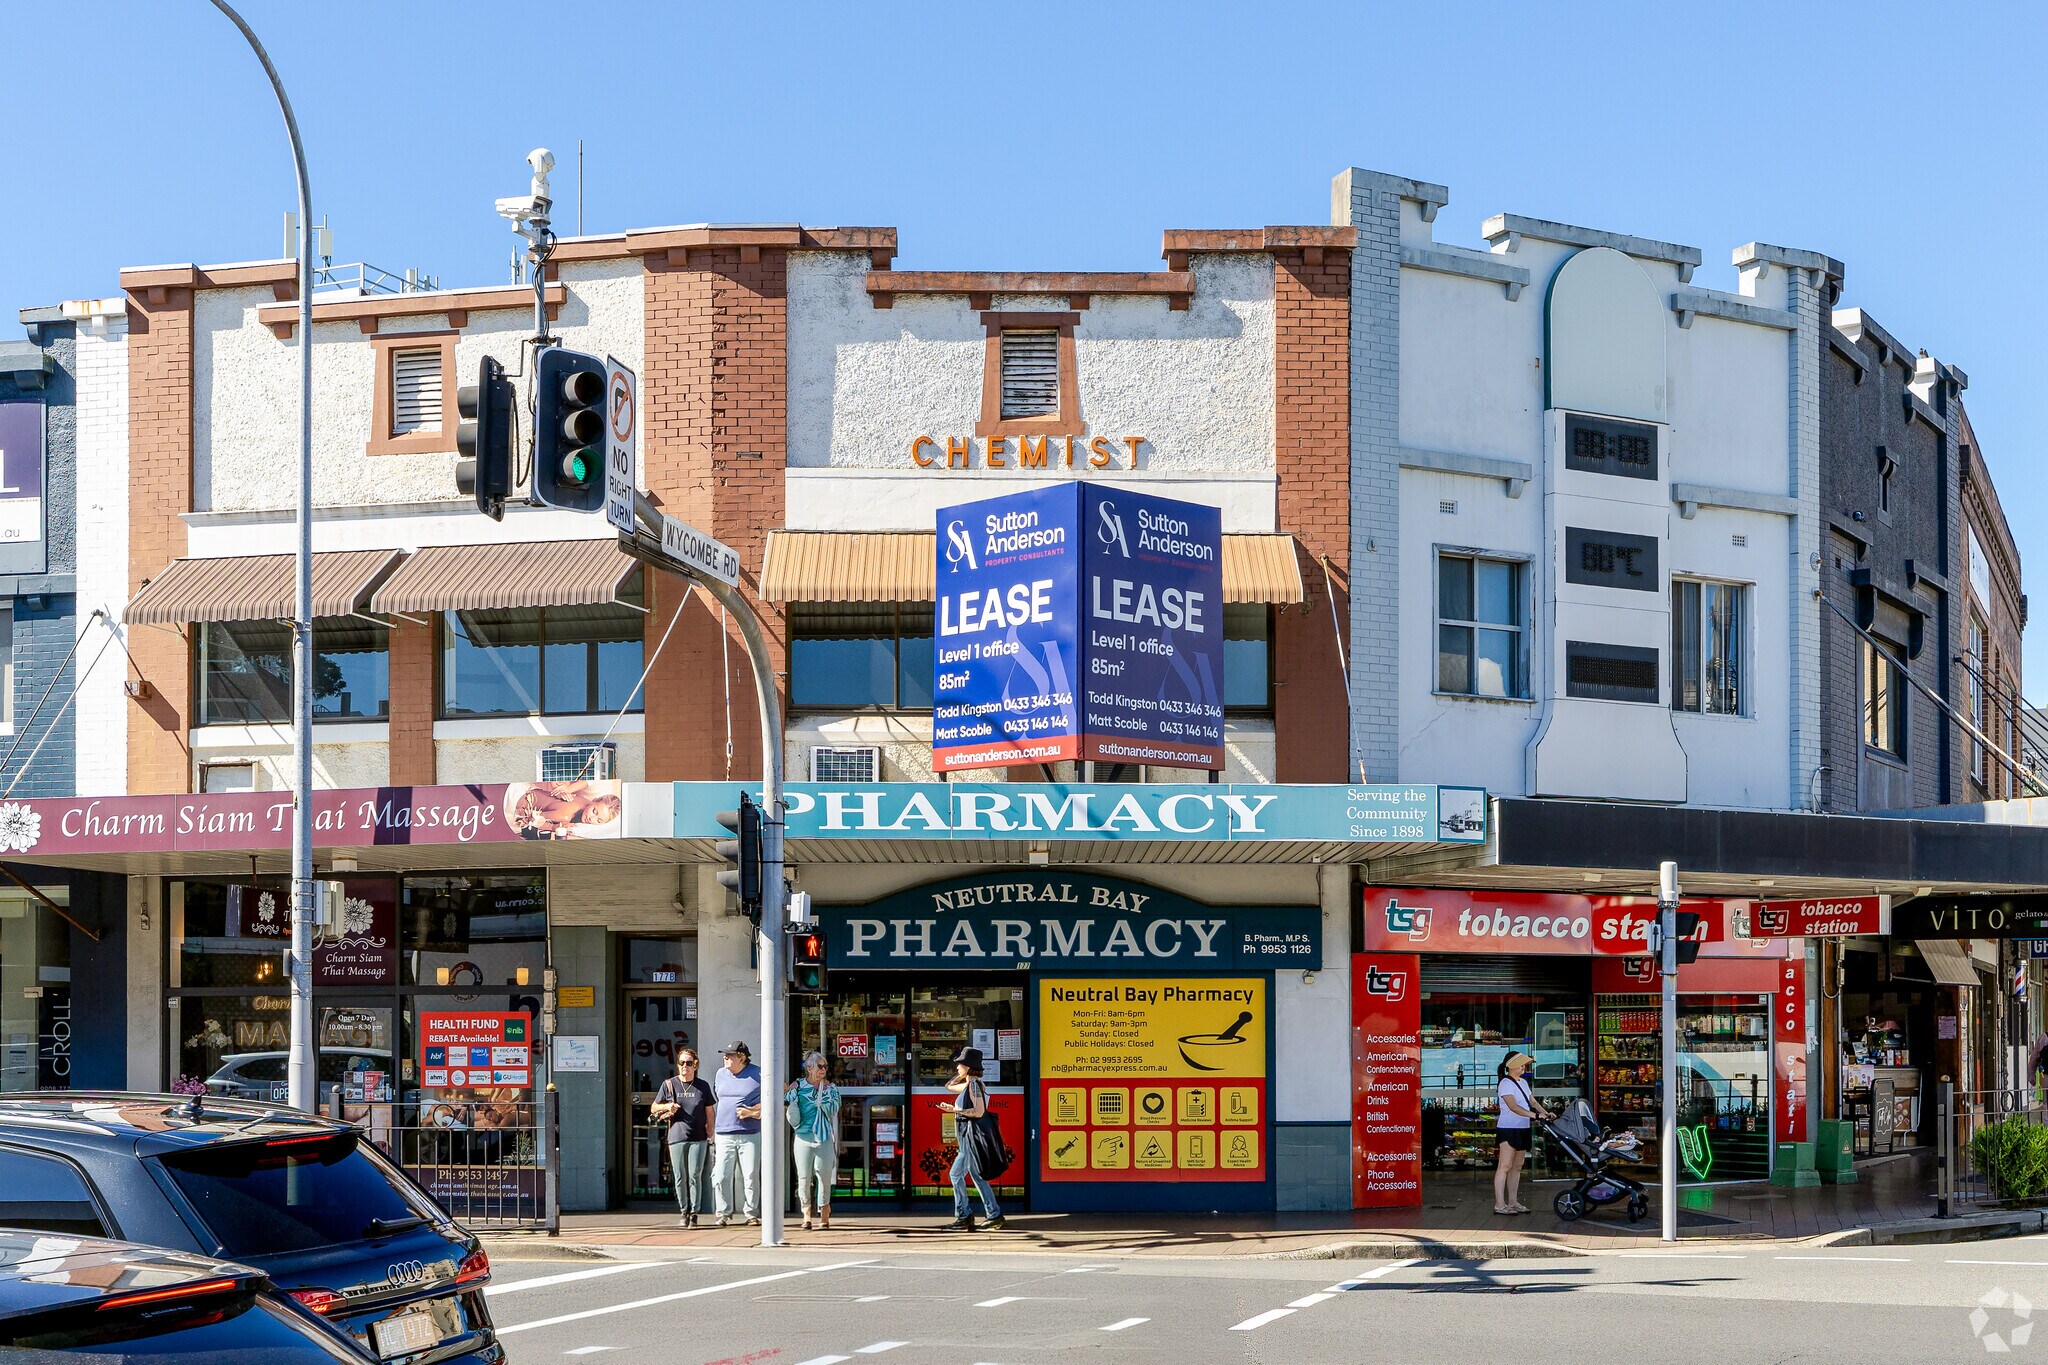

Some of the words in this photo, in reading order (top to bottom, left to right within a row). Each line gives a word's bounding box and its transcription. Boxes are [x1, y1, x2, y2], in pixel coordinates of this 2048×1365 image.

[912, 434, 1144, 468] CHEMIST
[613, 445, 628, 475] NO
[609, 476, 632, 502] RIGHT
[610, 500, 631, 526] TURN
[985, 511, 1038, 536] Sutton
[1138, 508, 1188, 537] Sutton
[985, 525, 1065, 555] Anderson
[1138, 532, 1213, 562] Anderson
[666, 522, 719, 571] WYCOMBE
[723, 553, 737, 578] RD
[985, 556, 1017, 567] PROPERTY
[1019, 548, 1065, 561] CONSULTANTS
[940, 579, 1053, 637] LEASE
[1092, 575, 1204, 633] LEASE
[939, 644, 971, 664] Level
[974, 643, 980, 659] 1
[983, 640, 1019, 658] office
[1092, 630, 1127, 650] Level
[1130, 635, 1136, 651] 1
[1139, 638, 1174, 657] office
[936, 706, 959, 719] Todd
[961, 700, 1002, 717] Kingston
[1004, 697, 1029, 711] 0433
[1031, 694, 1051, 708] 346
[1052, 692, 1072, 705] 346
[1088, 691, 1114, 707] Todd
[1115, 694, 1157, 712] Kingston
[1160, 699, 1183, 714] 0433
[1185, 702, 1202, 716] 346
[1204, 704, 1222, 718] 346
[936, 726, 958, 740] Matt
[960, 724, 992, 738] Scoble
[1004, 719, 1030, 733] 0433
[1032, 717, 1049, 730] 146
[1050, 715, 1068, 728] 146
[1088, 713, 1112, 728] Matt
[1114, 716, 1147, 732] Scoble
[1160, 721, 1183, 735] 0433
[1185, 724, 1201, 737] 146
[1203, 725, 1219, 739] 146
[945, 744, 1061, 766] suttonanderson.com.au
[1098, 742, 1212, 764] suttonanderson.com.au
[1347, 789, 1400, 804] Serving
[1403, 789, 1426, 801] the
[755, 792, 1278, 832] PHARMACY
[1346, 807, 1427, 822] Community
[61, 801, 165, 837] Charm
[177, 804, 255, 841] Siam
[266, 802, 346, 832] Tai
[358, 801, 495, 841] Massage
[1350, 825, 1387, 837] Since
[1392, 825, 1424, 837] 1898
[932, 883, 1078, 913] NEUTRAL
[1088, 886, 1150, 914] BAY
[1800, 902, 1862, 917] tobacco
[2015, 909, 2043, 920] gelato
[1385, 898, 1433, 942] tsg
[1458, 908, 1590, 938] tobacco
[1600, 911, 1709, 942] stan
[1758, 905, 1789, 934] tsg
[1804, 918, 1859, 934] station
[846, 919, 1227, 959] PHARMACY
[1244, 934, 1253, 942] B.
[326, 952, 356, 963] Charm
[359, 952, 382, 962] Siam
[1243, 945, 1256, 954] Ph
[1261, 945, 1287, 954] 9953
[1290, 945, 1312, 954] 1126
[322, 965, 345, 976] Thai
[348, 967, 386, 979] Massage
[1366, 965, 1407, 1002] tsg
[1051, 987, 1118, 1002] Neutral
[1126, 987, 1158, 1005] Bay
[1164, 987, 1254, 1004] Pharmacy
[1073, 1010, 1106, 1018] Mon-Fri:
[1107, 1010, 1145, 1019] 8am-6pm
[430, 1020, 468, 1029] HEALTH
[471, 1020, 499, 1029] FUND
[1071, 1020, 1109, 1029] Saturday:
[1110, 1020, 1148, 1029] 9am-3pm
[53, 998, 71, 1076] CROLL
[429, 1034, 458, 1042] REBATE
[460, 1034, 499, 1043] Available!
[1079, 1030, 1111, 1039] Sunday:
[1113, 1030, 1139, 1038] Closed
[1366, 1033, 1416, 1044] Accessories
[839, 1045, 866, 1055] OPEN
[1064, 1040, 1088, 1048] Public
[1090, 1040, 1126, 1049] Holidays:
[1127, 1040, 1154, 1048] Closed
[1076, 1056, 1089, 1064] Ph:
[1090, 1056, 1100, 1064] 02
[1101, 1056, 1122, 1064] 9953
[1123, 1056, 1143, 1064] 2695
[1367, 1052, 1408, 1061] American
[1051, 1064, 1168, 1073] nb@pharmacyexpress.com.au
[273, 1088, 289, 1099] OPE
[1367, 1082, 1409, 1091] American
[1367, 1095, 1389, 1105] Drinks
[1366, 1112, 1389, 1122] British
[1367, 1152, 1417, 1162] Accessories
[439, 1170, 456, 1180] Ph:
[1367, 1170, 1395, 1180] Phone
[1367, 1180, 1417, 1191] Accessories
